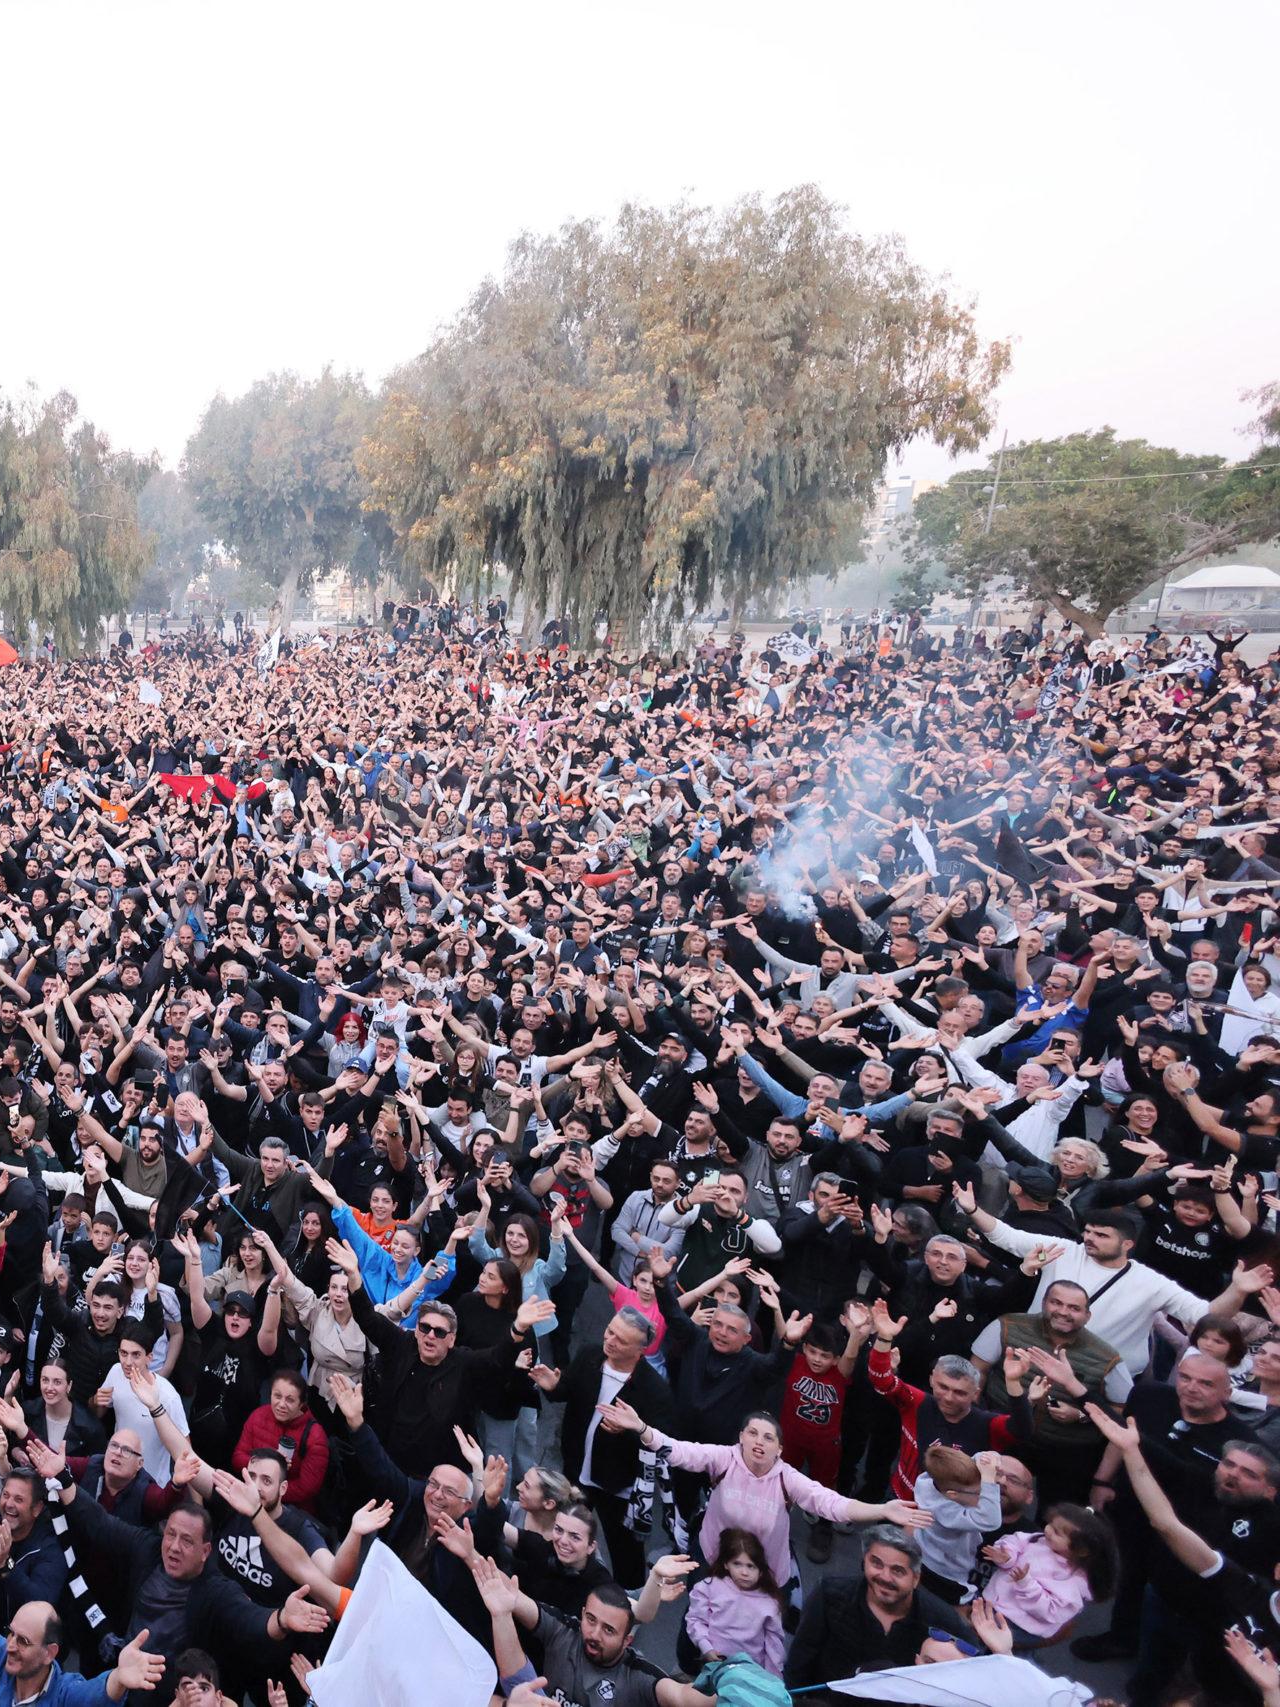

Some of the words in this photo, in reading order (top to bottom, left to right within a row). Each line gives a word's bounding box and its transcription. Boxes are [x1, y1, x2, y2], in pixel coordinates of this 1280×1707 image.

[792, 1375, 840, 1404] JORDAN
[796, 1394, 832, 1425] 23
[219, 1538, 273, 1588] adidas
